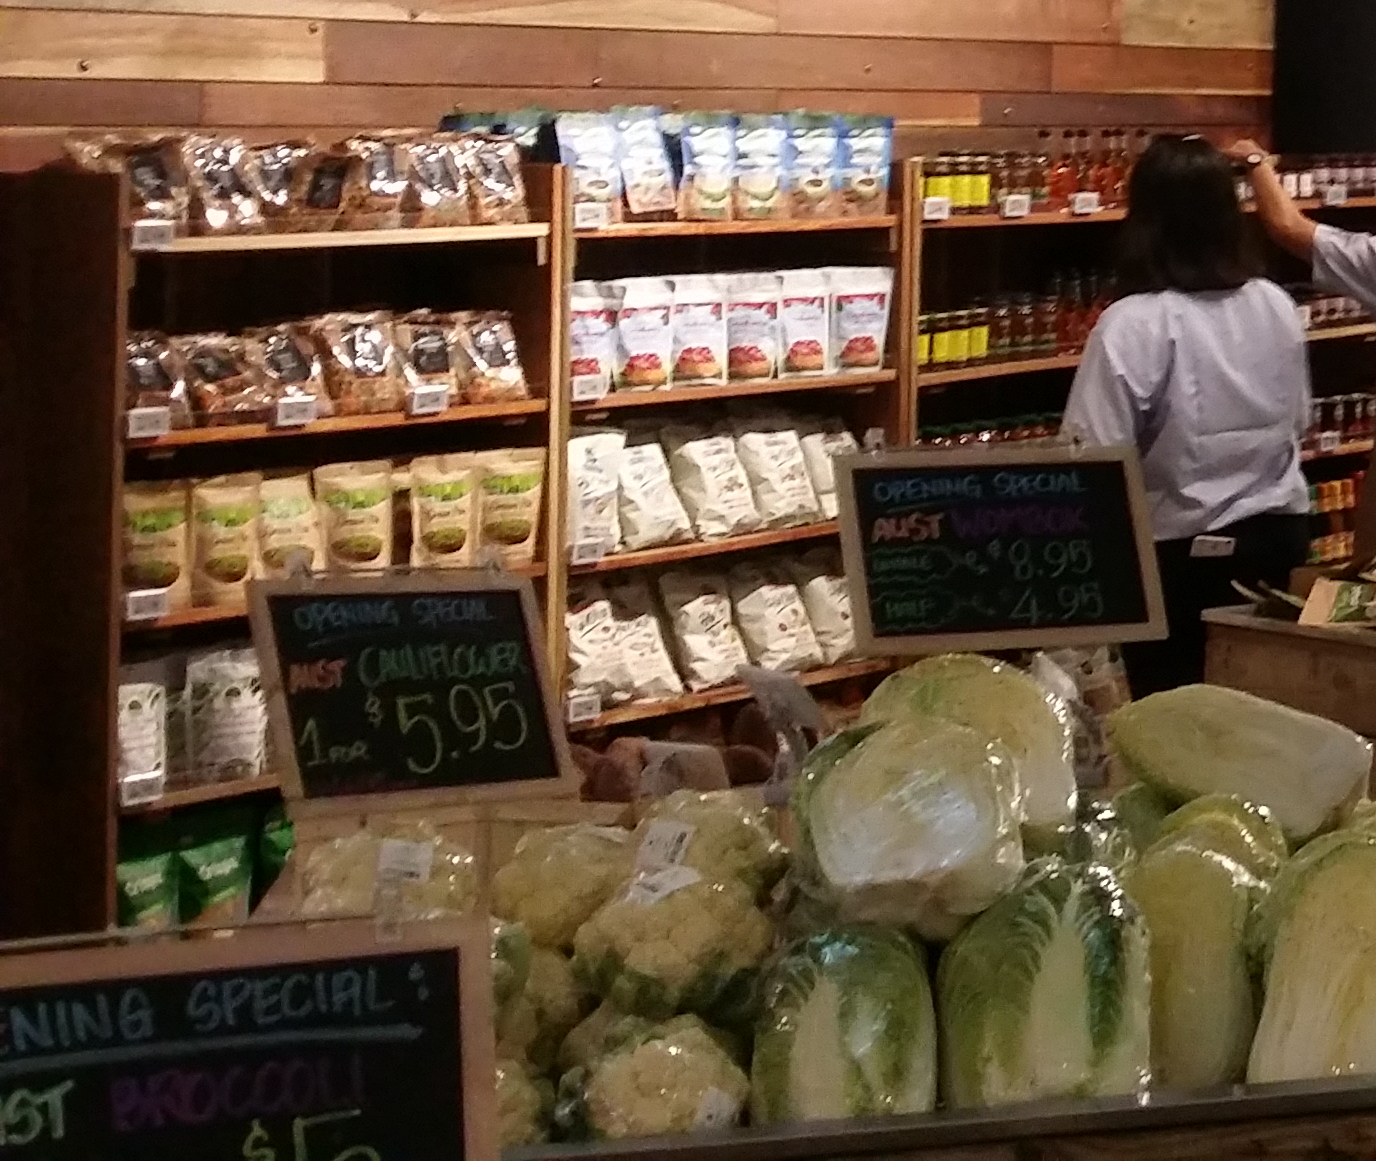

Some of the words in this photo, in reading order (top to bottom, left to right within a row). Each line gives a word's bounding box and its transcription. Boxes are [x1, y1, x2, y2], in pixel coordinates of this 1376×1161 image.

[873, 474, 984, 505] OPENING
[992, 470, 1089, 496] SPECIAL
[871, 510, 946, 544] AUST
[293, 599, 400, 632] OPENING
[411, 597, 496, 627] SPECIAL
[0, 987, 154, 1053] NING
[0, 1076, 76, 1146] ST
